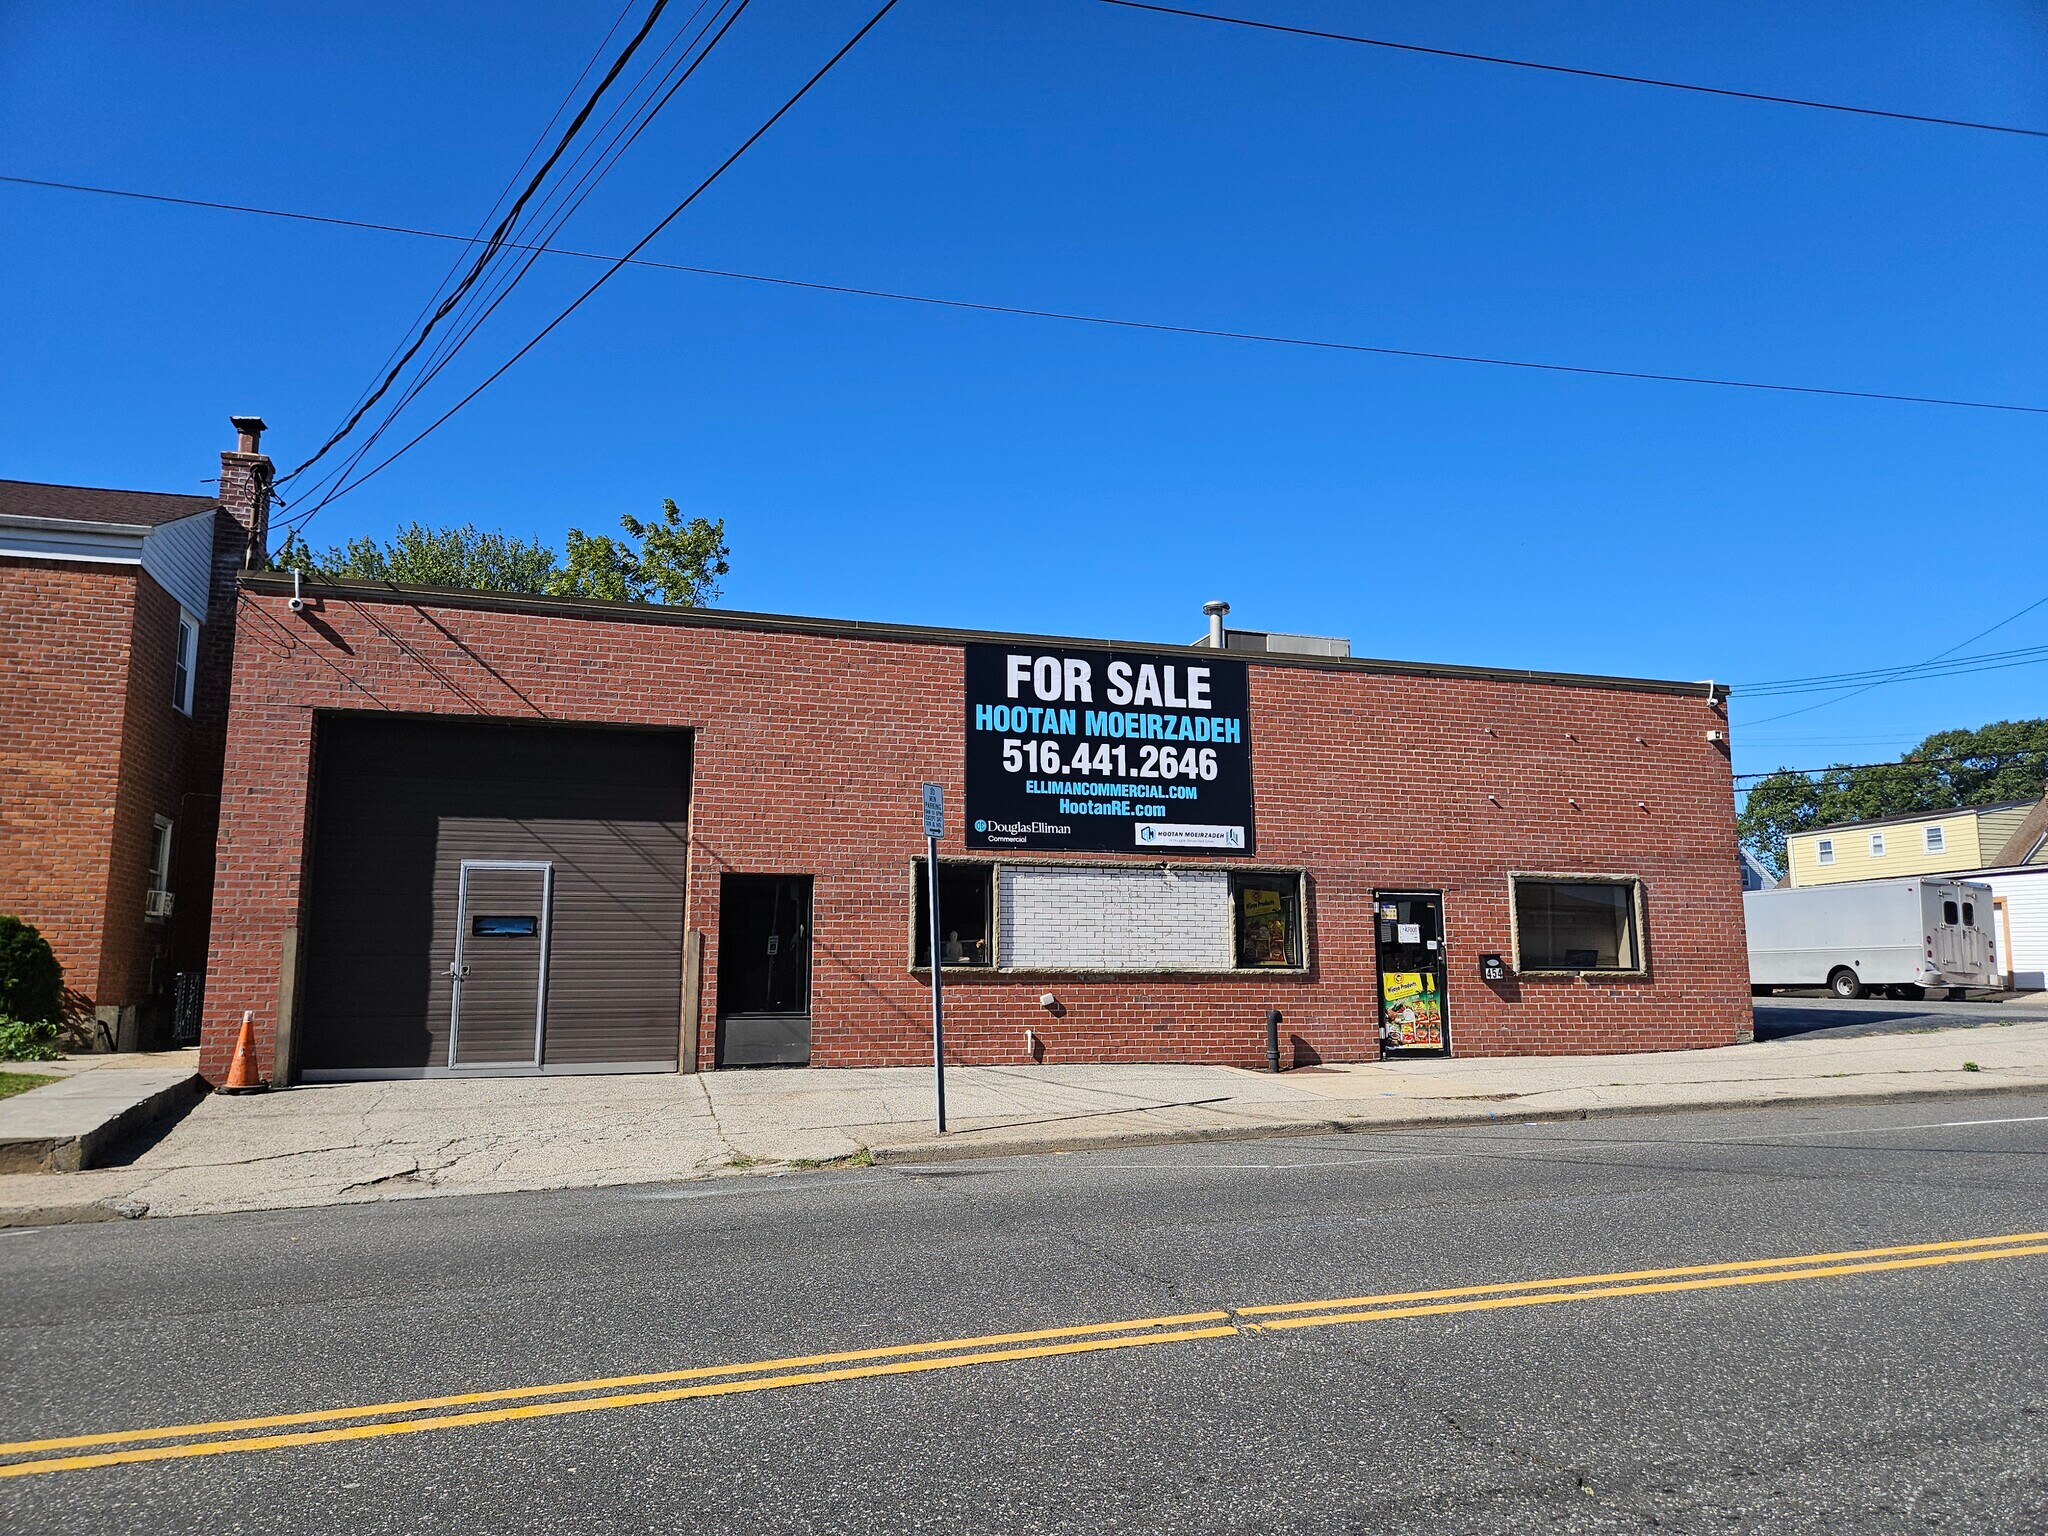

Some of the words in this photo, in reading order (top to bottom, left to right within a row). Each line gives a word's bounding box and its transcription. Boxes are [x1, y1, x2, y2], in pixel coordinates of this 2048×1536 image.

[1006, 654, 1093, 703] FOR
[1106, 660, 1212, 709] SALE
[975, 703, 1076, 735] HOOTAN
[1085, 710, 1241, 744] MOEIRZADEH
[1002, 738, 1218, 781] 516.441.2646
[1026, 780, 1198, 799] ELLIMANCOMMERCIAL.COM
[925, 801, 942, 811] PARKING
[1059, 798, 1166, 817] HootanRE.com
[988, 835, 1027, 843] Commercial
[1486, 968, 1502, 979] 454
